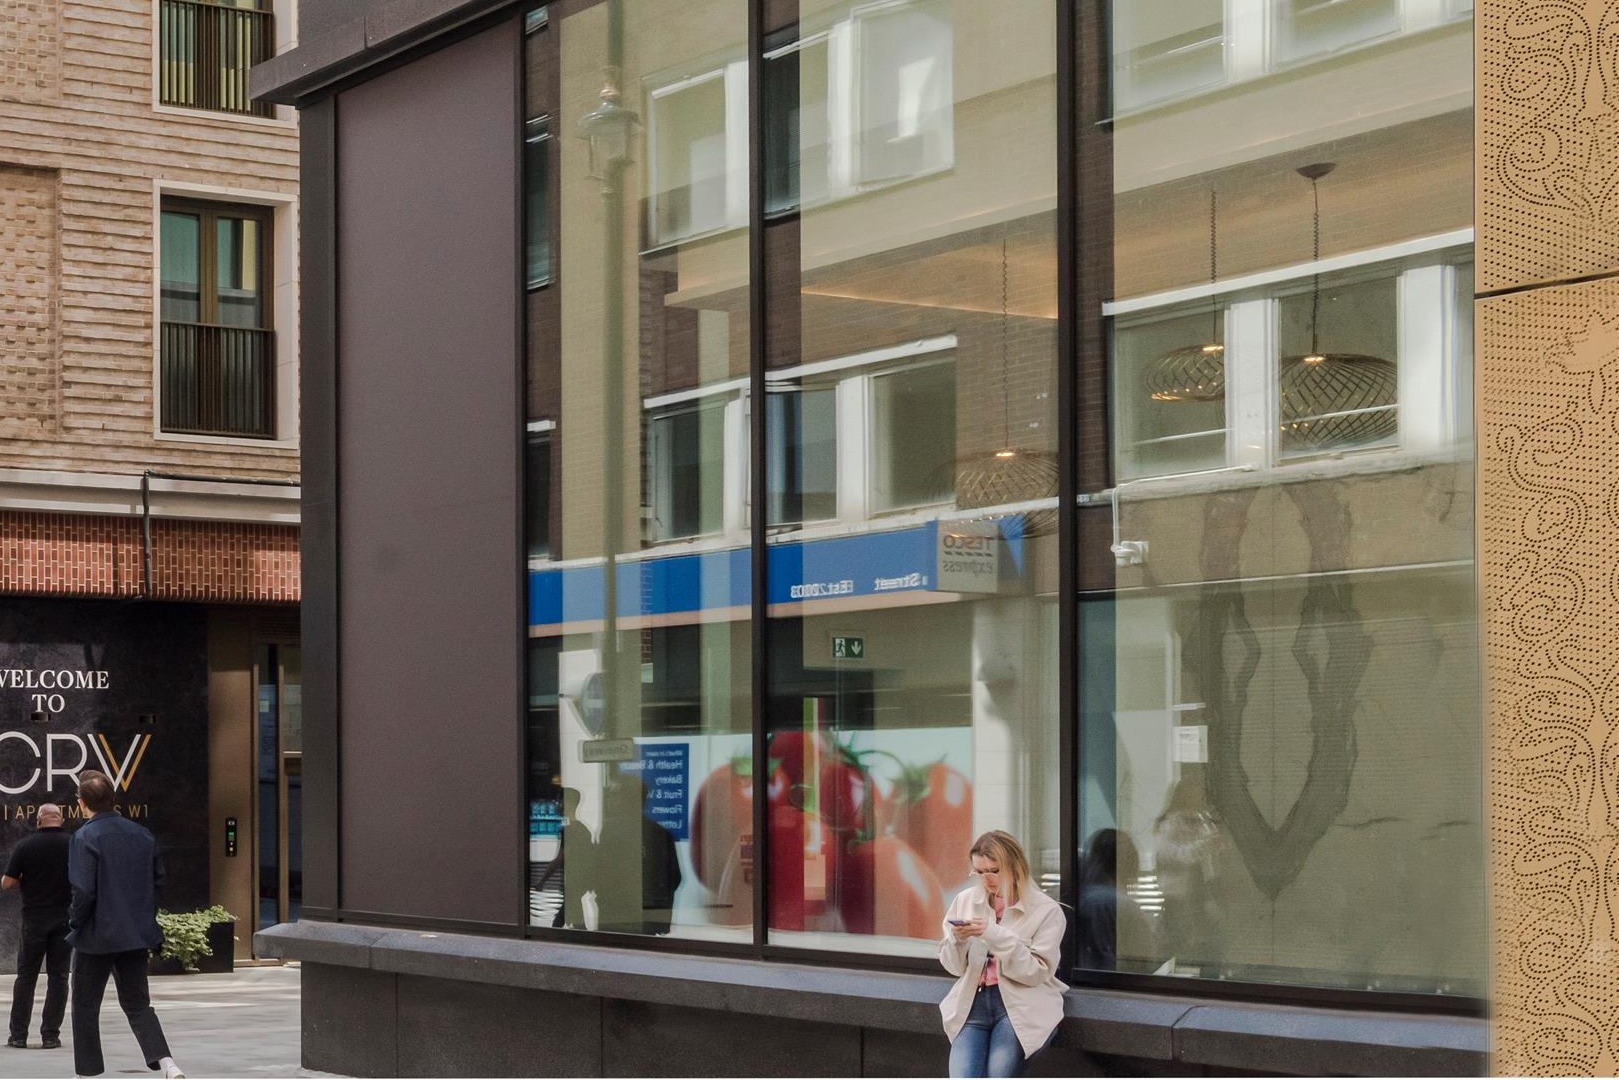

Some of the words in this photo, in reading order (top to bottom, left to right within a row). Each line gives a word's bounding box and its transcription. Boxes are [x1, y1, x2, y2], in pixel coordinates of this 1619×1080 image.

[31, 694, 66, 713] TO
[15, 804, 123, 820] APTMS
[128, 803, 149, 819] W1
